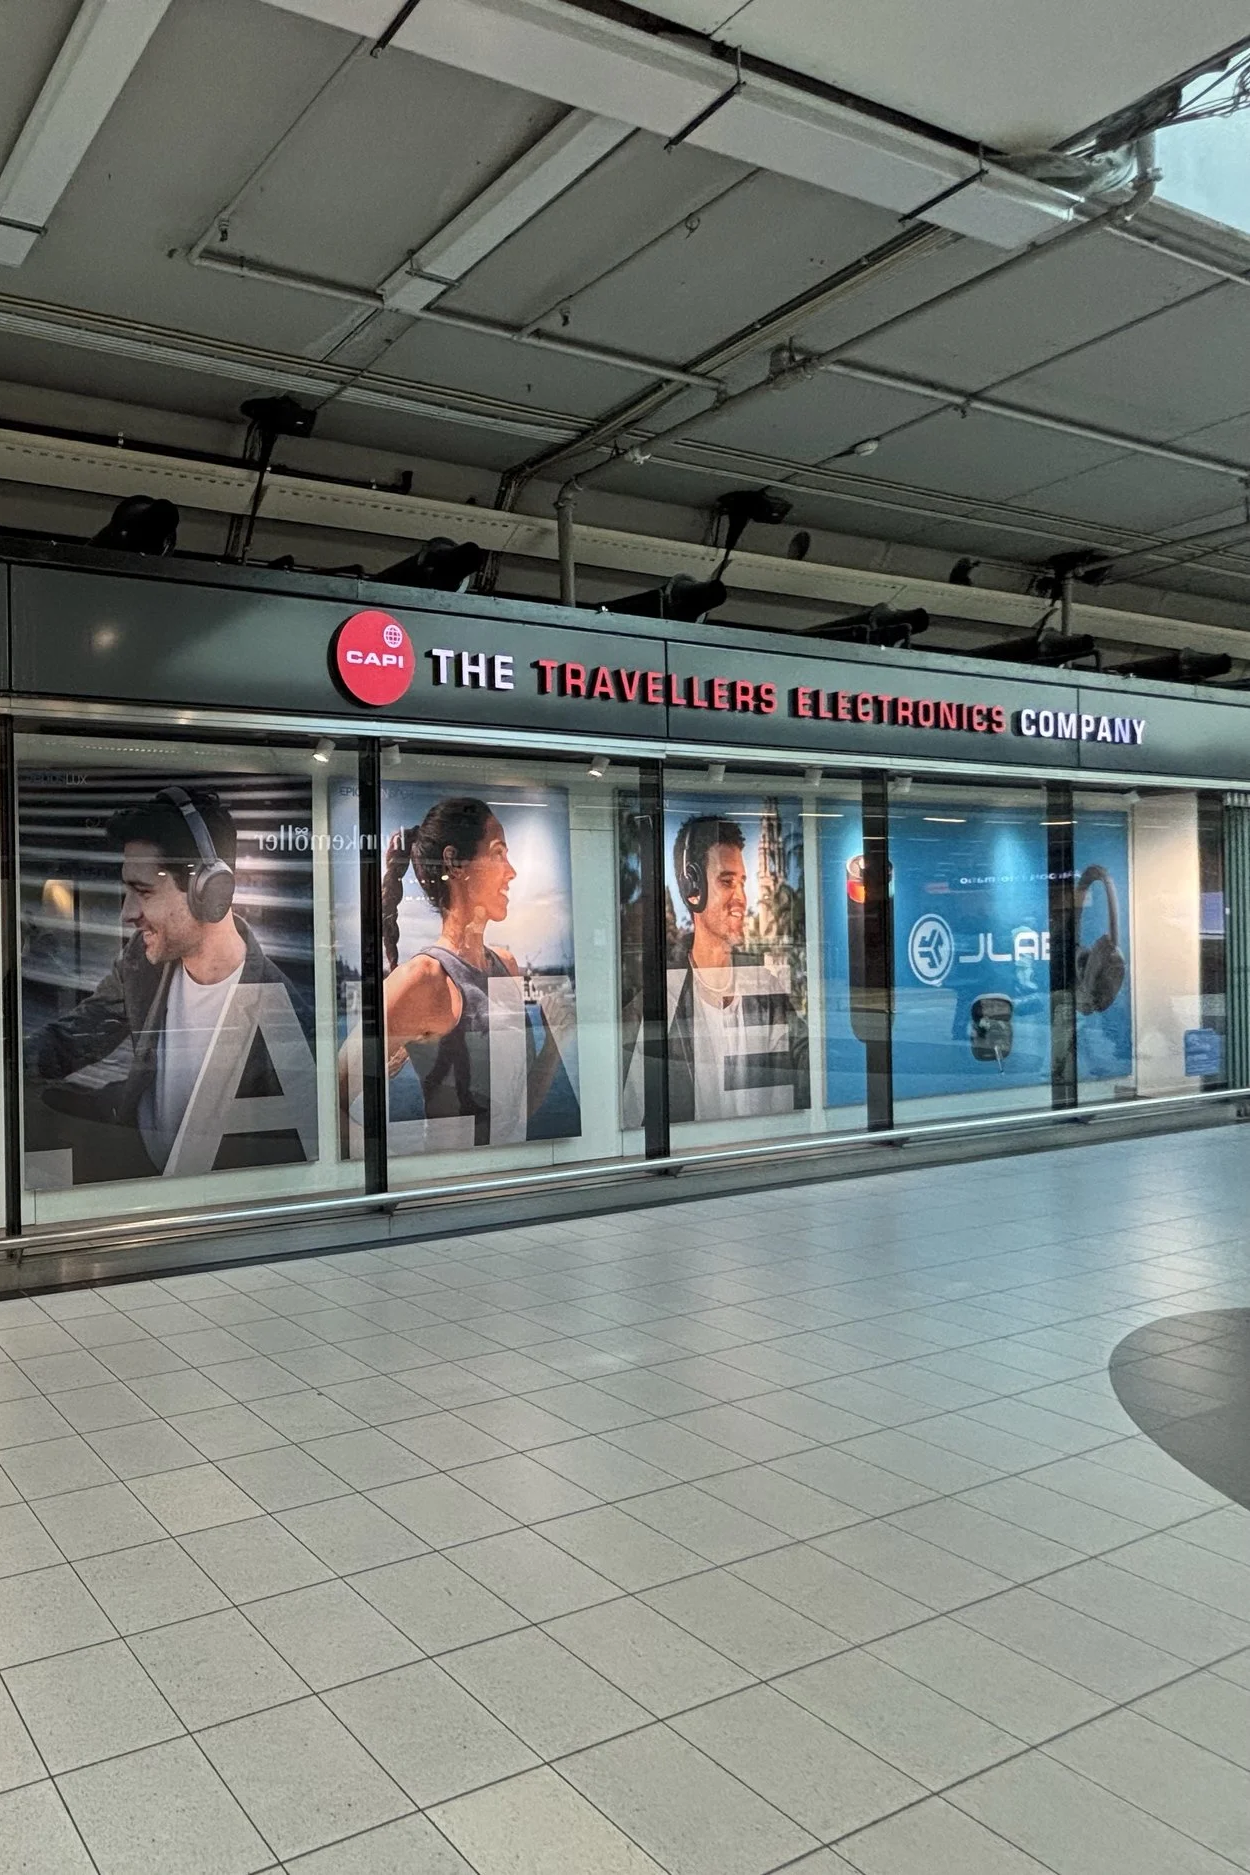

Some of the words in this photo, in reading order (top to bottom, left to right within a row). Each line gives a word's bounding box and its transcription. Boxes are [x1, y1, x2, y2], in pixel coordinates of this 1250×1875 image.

[346, 650, 404, 669] CAPI
[430, 648, 514, 690] THE
[536, 658, 778, 714] TRAVELLERS
[796, 686, 1006, 733] ELECTRONICS
[1021, 708, 1145, 745] COMPANY
